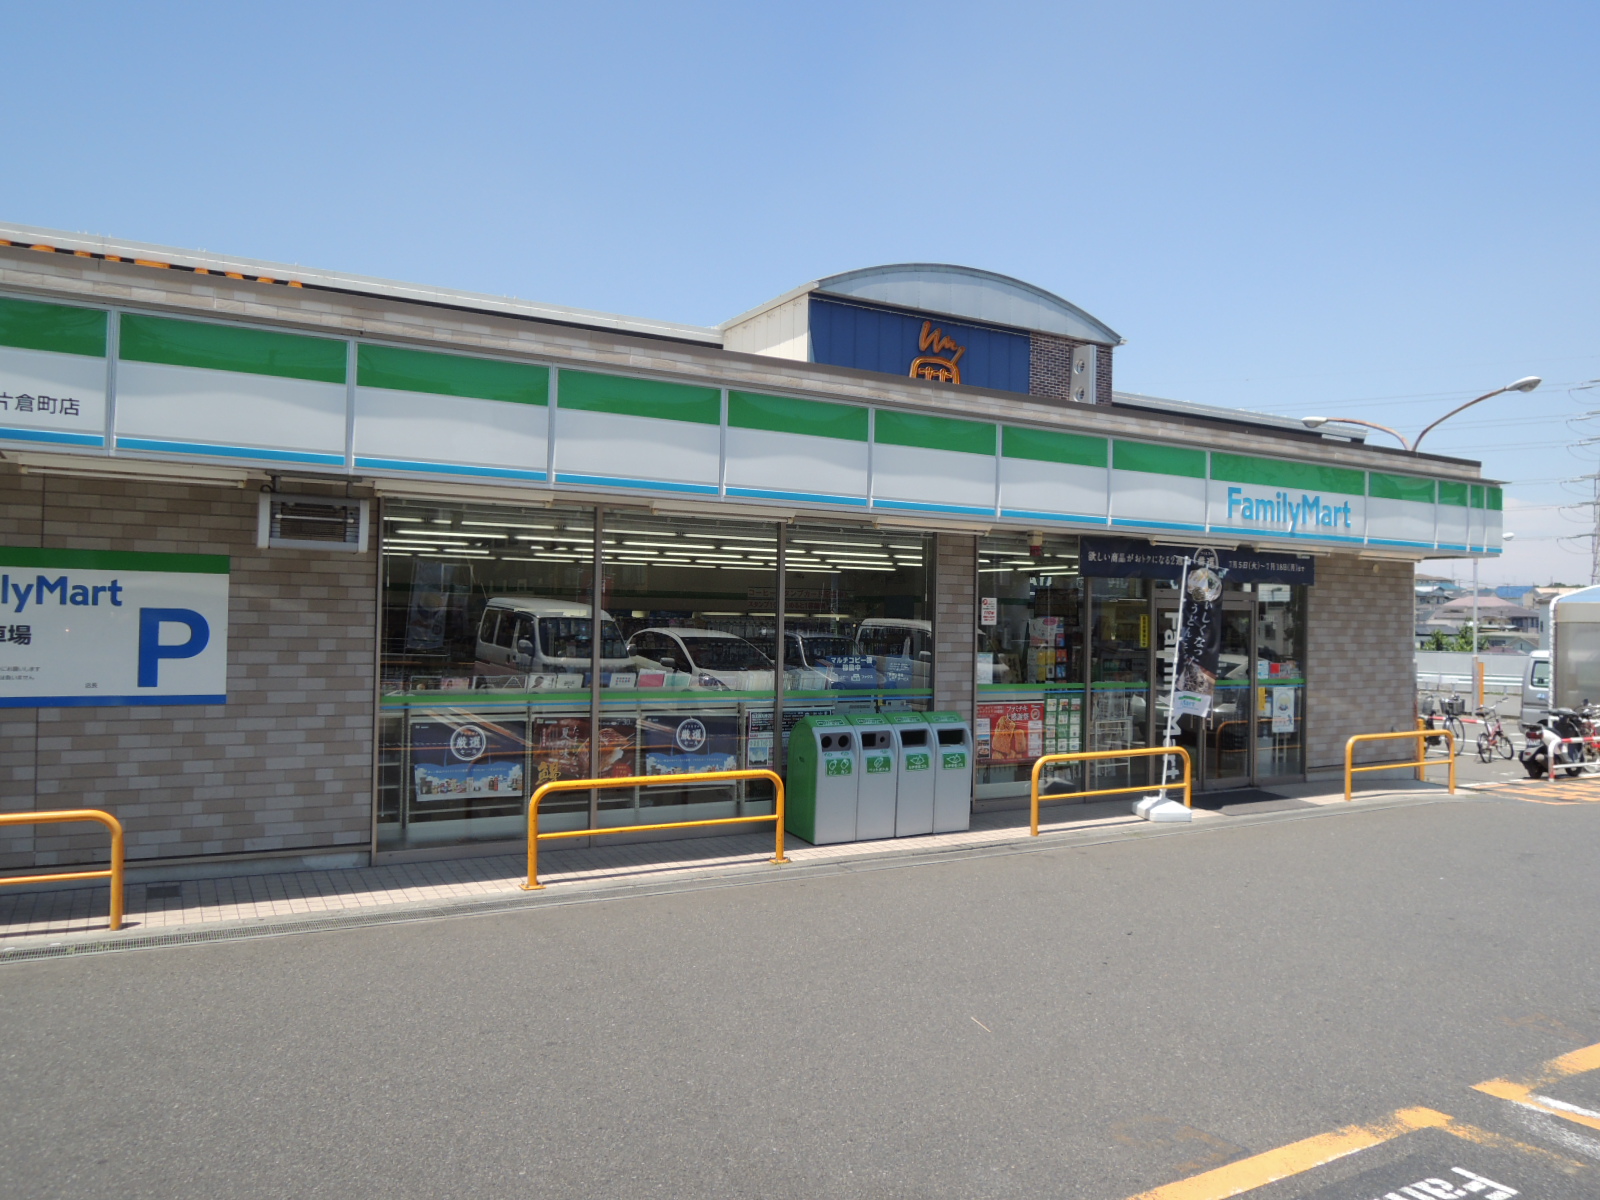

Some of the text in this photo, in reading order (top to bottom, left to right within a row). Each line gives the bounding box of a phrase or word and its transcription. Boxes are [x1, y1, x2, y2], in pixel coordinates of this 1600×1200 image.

[0, 392, 80, 416] 片倉町店
[1228, 487, 1352, 533] FamilyMart
[1, 574, 123, 613] lyMart
[137, 607, 210, 688] P
[456, 736, 482, 748] 厳選
